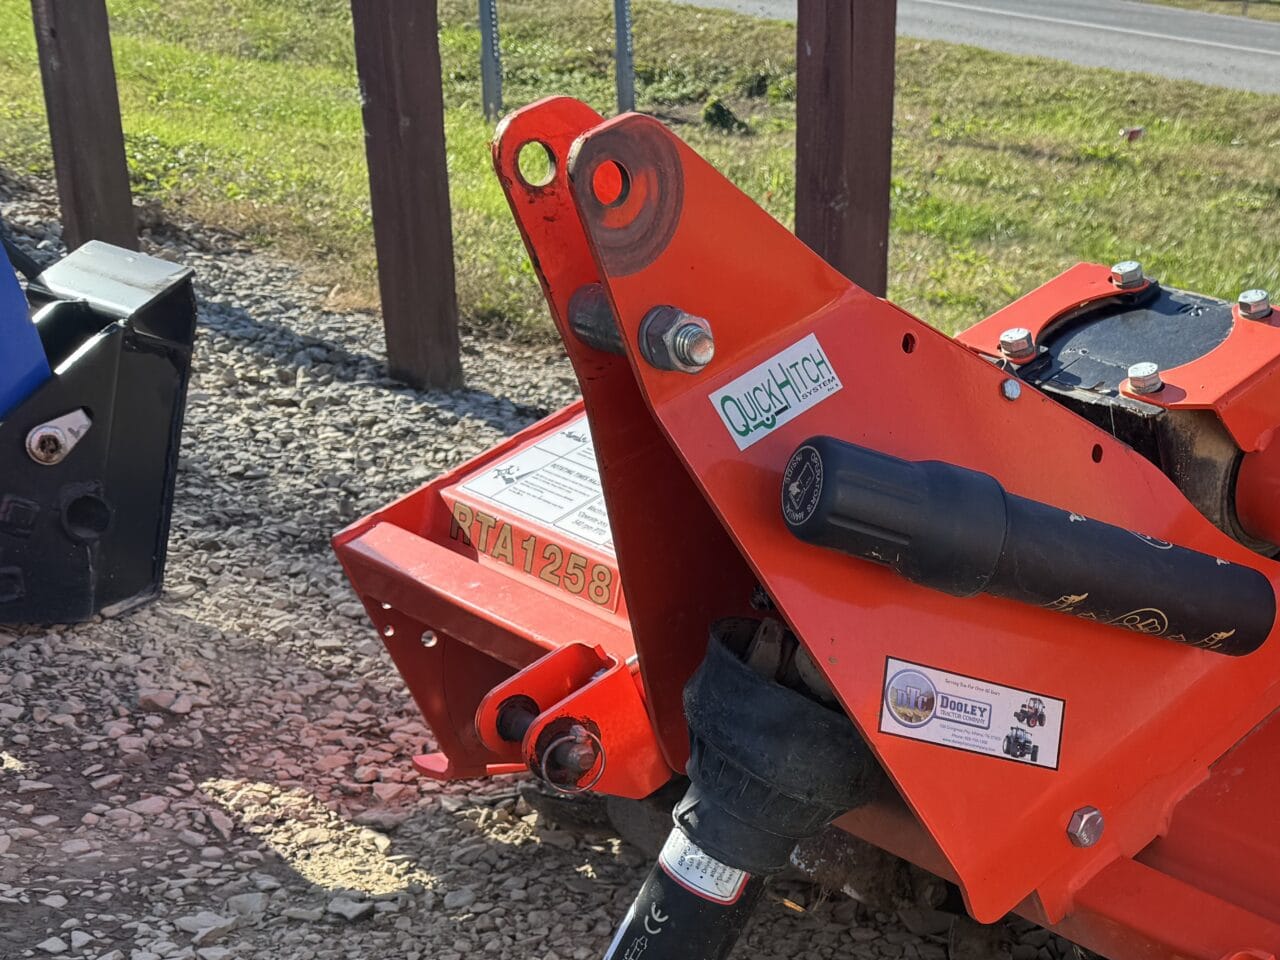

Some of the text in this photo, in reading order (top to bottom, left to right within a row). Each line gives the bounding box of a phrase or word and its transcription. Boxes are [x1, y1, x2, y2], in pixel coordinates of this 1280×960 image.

[801, 375, 836, 400] SYSTEM
[450, 501, 613, 605] RTA1258
[940, 695, 987, 717] DOOLEY
[940, 710, 985, 724] TRACTOR COMPANY
